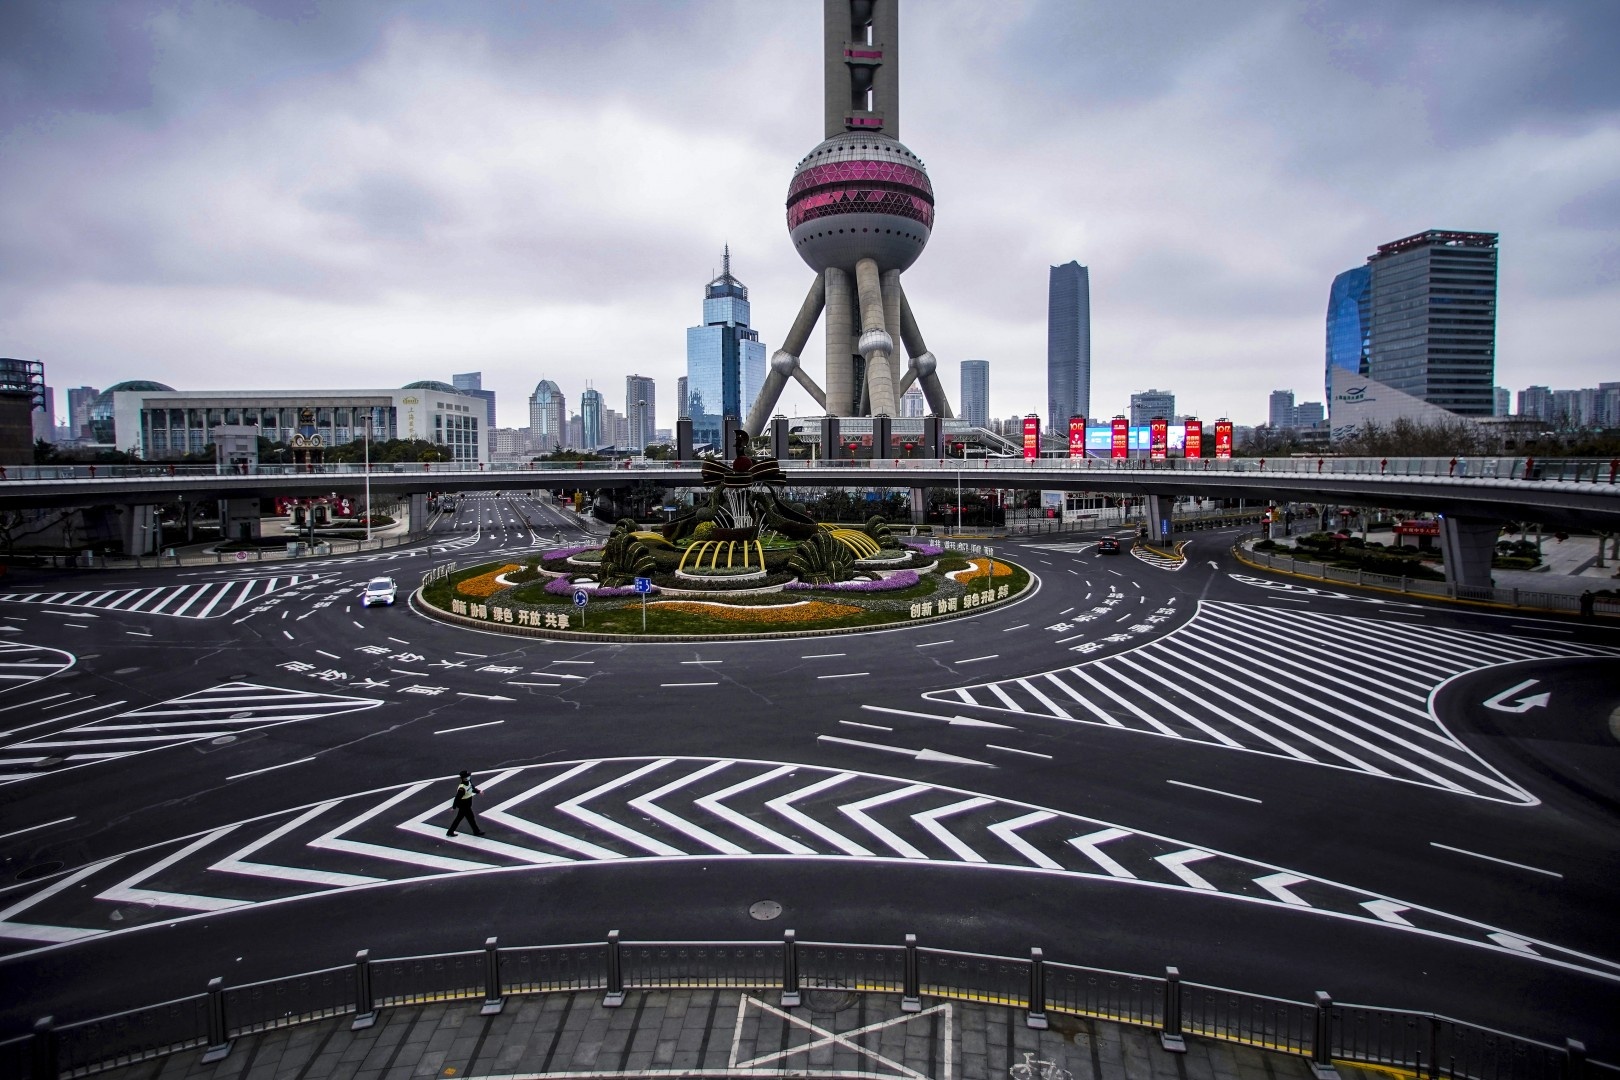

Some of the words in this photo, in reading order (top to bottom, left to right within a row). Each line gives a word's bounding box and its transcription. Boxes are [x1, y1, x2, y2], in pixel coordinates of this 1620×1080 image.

[470, 602, 488, 619] 协调
[493, 606, 514, 623] 绿色
[518, 609, 541, 627] 开放
[545, 612, 570, 630] 共享
[910, 602, 933, 618] 创新
[937, 597, 958, 613] 协调
[963, 593, 980, 608] 绿色
